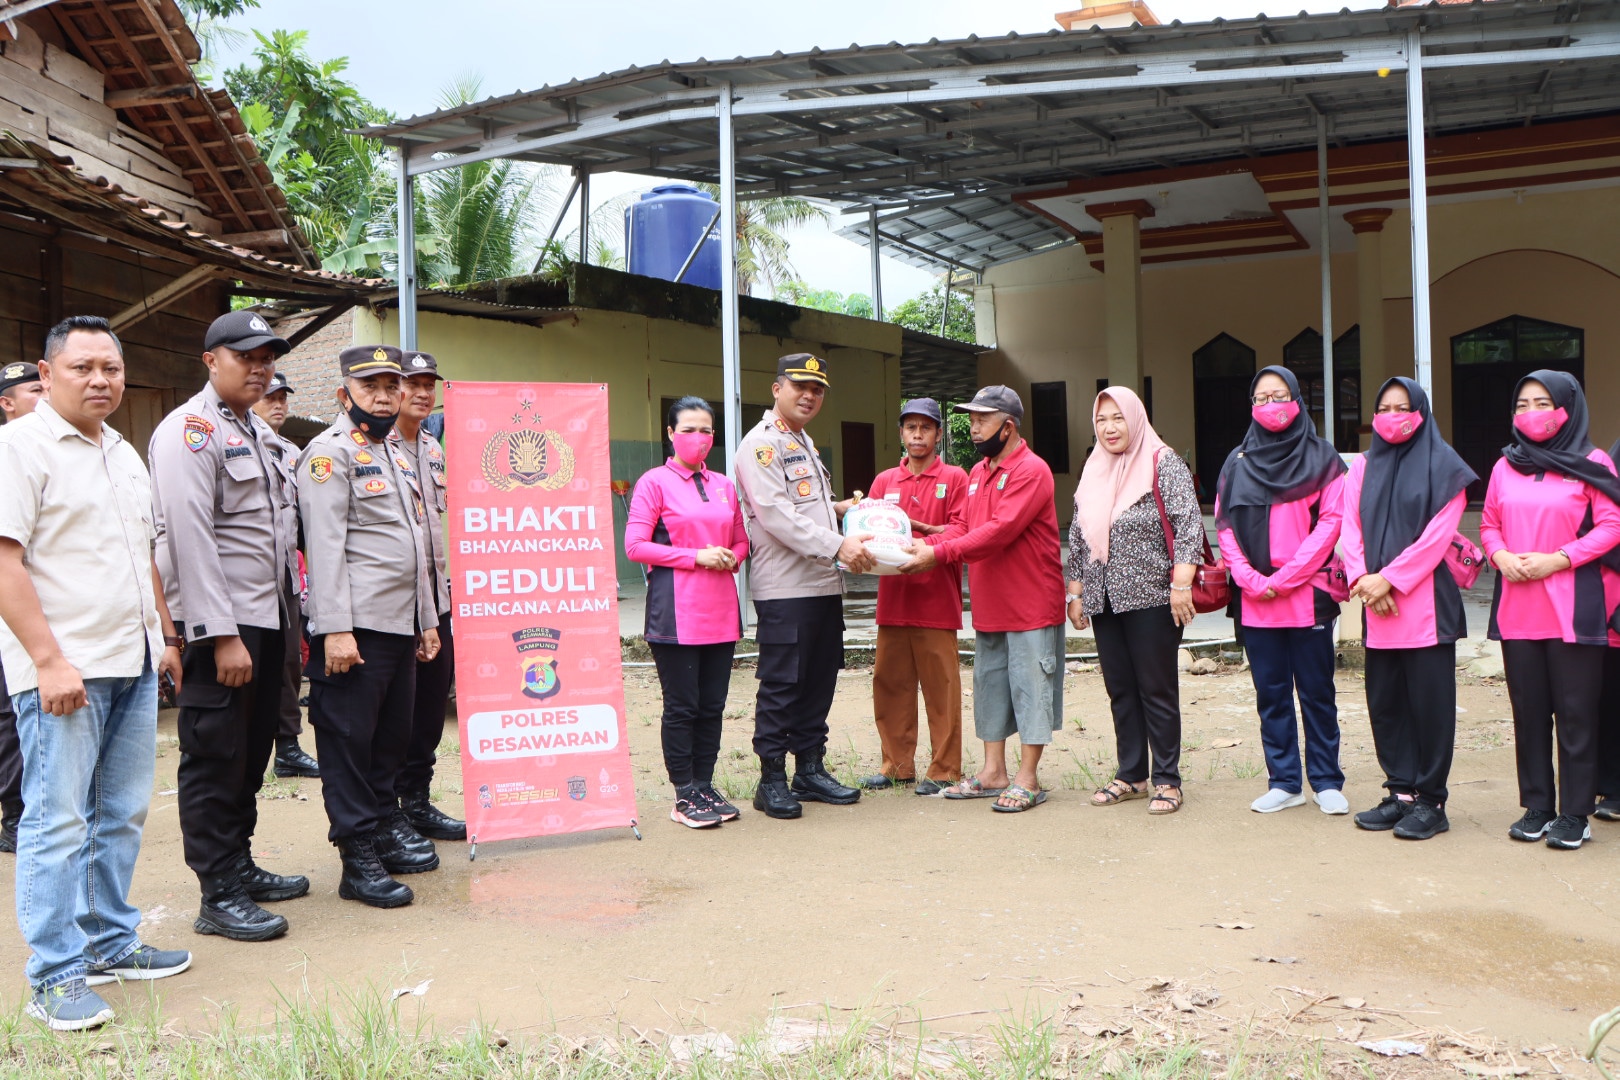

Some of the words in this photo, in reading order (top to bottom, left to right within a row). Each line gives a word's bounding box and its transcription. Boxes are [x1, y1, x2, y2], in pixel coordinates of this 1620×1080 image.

[464, 505, 596, 533] BHAKTI
[459, 537, 604, 555] BHAYANGKARA
[465, 566, 596, 596] PEDULI
[459, 601, 552, 618] BENCANA
[557, 597, 610, 613] ALAM
[520, 632, 553, 640] PESAWARAN
[522, 627, 550, 635] POLRES
[518, 643, 556, 652] LAMPUNG
[501, 709, 579, 729] POLRES
[479, 730, 609, 754] PESAWARAN
[498, 789, 559, 802] PRESISI
[599, 784, 619, 793] G20
